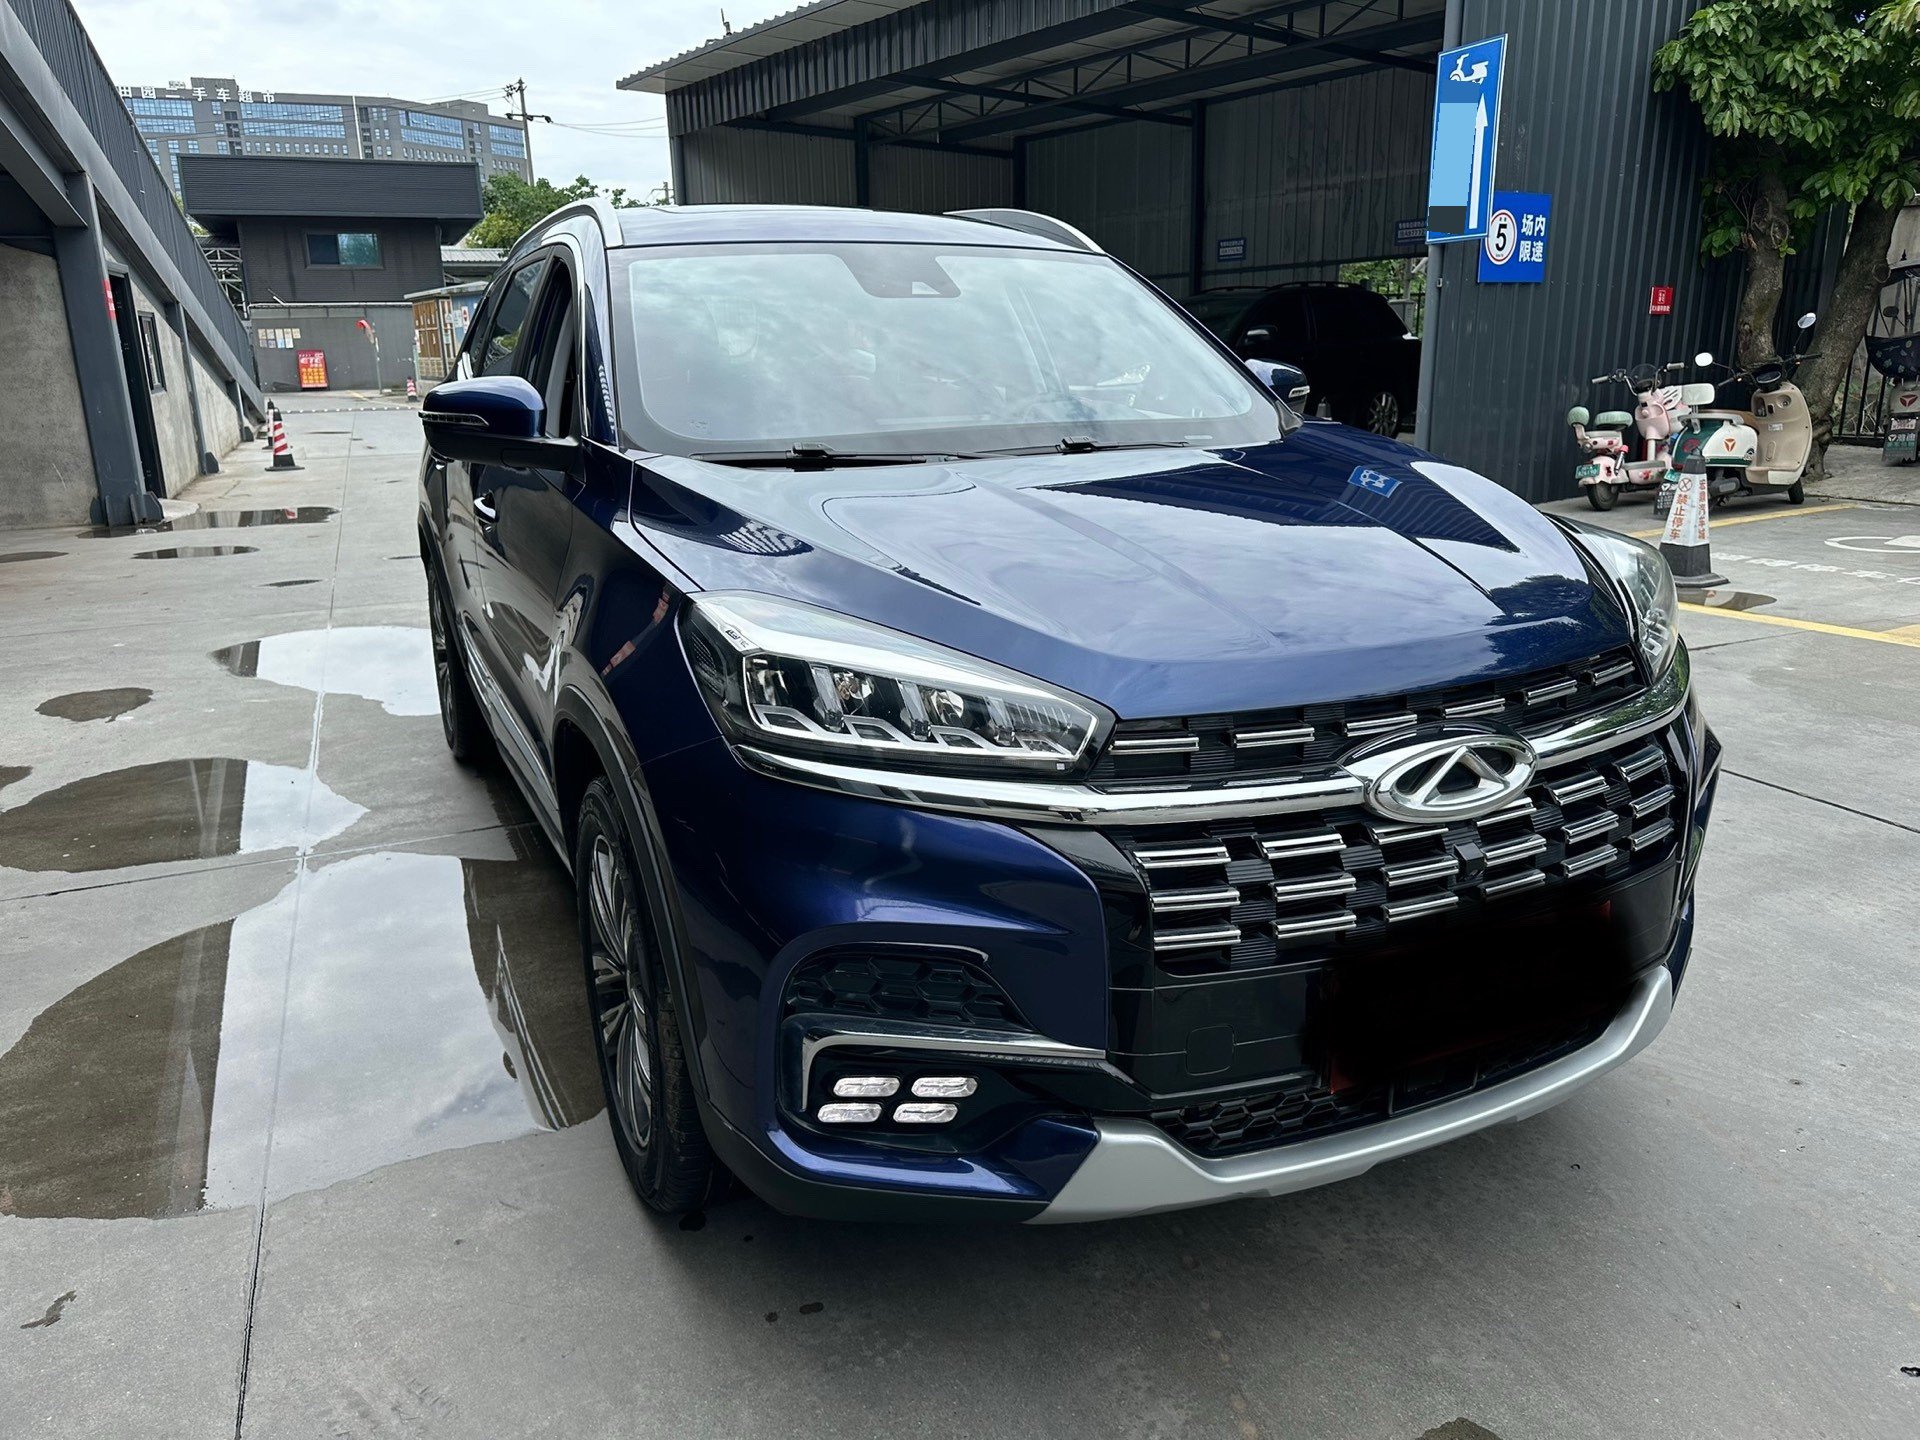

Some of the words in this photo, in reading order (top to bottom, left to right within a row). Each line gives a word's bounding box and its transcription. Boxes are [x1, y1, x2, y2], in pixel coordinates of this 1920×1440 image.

[1495, 223, 1507, 251] 5
[1521, 214, 1546, 237] 场内
[1518, 240, 1544, 263] 限速
[1669, 493, 1689, 539] 禁止停车
